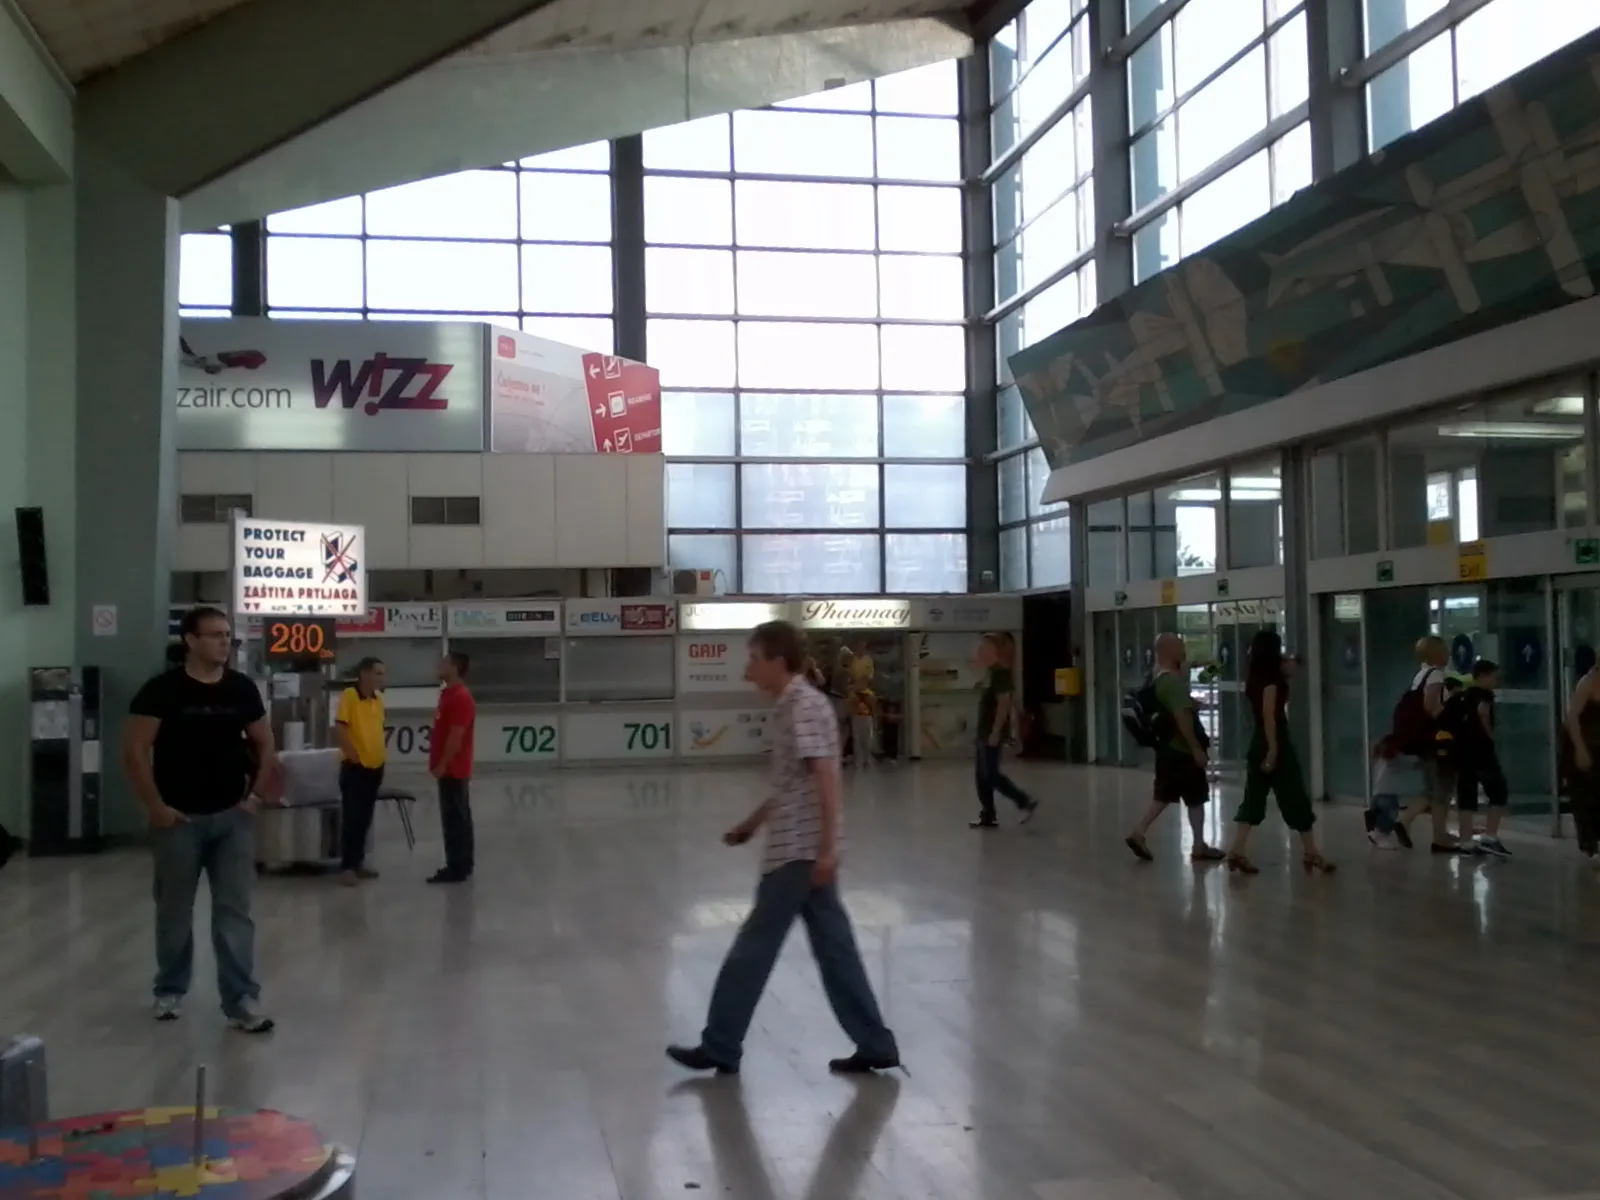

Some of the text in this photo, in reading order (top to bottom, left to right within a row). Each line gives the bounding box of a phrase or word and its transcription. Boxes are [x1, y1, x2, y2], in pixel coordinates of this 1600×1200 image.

[243, 527, 306, 543] PROTECT
[244, 546, 285, 560] YOUR
[243, 565, 314, 579] BAGGAGE
[243, 583, 358, 600] ZAŠTITA PRTLJAGA
[802, 600, 911, 625] Pharmacy
[269, 622, 324, 653] 280
[688, 643, 728, 659] GRIP
[502, 726, 556, 754] 702
[623, 723, 671, 750] 701
